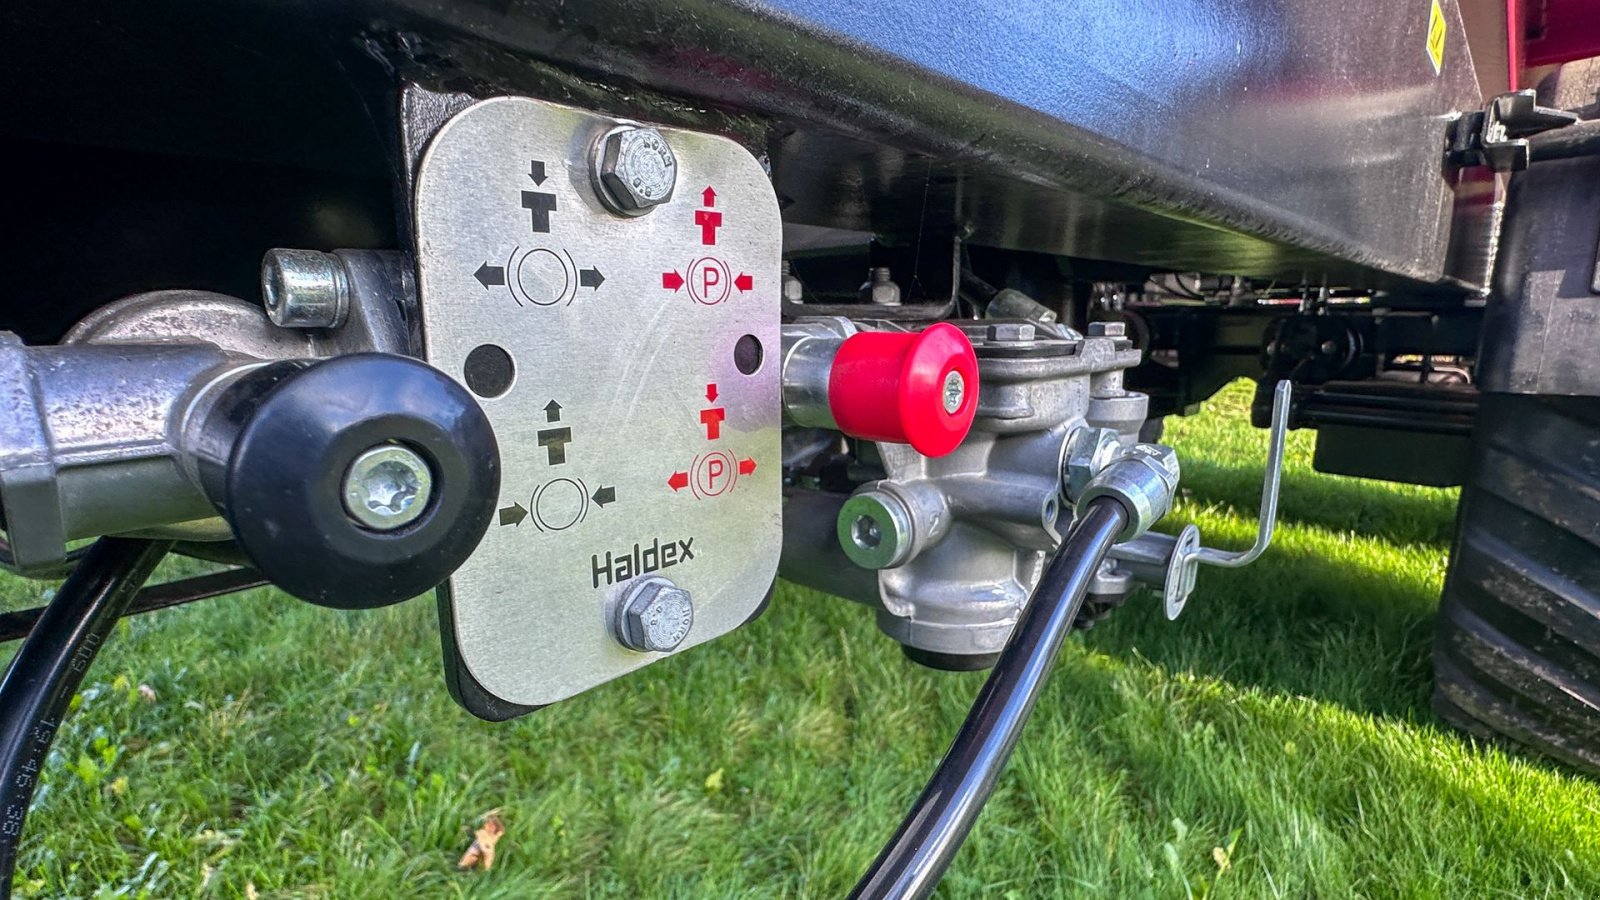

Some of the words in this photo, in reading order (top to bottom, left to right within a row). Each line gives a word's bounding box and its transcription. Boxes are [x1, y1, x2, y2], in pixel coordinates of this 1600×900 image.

[703, 266, 720, 299] P
[708, 459, 724, 490] P
[927, 510, 940, 538] 2
[591, 536, 695, 589] Haldex
